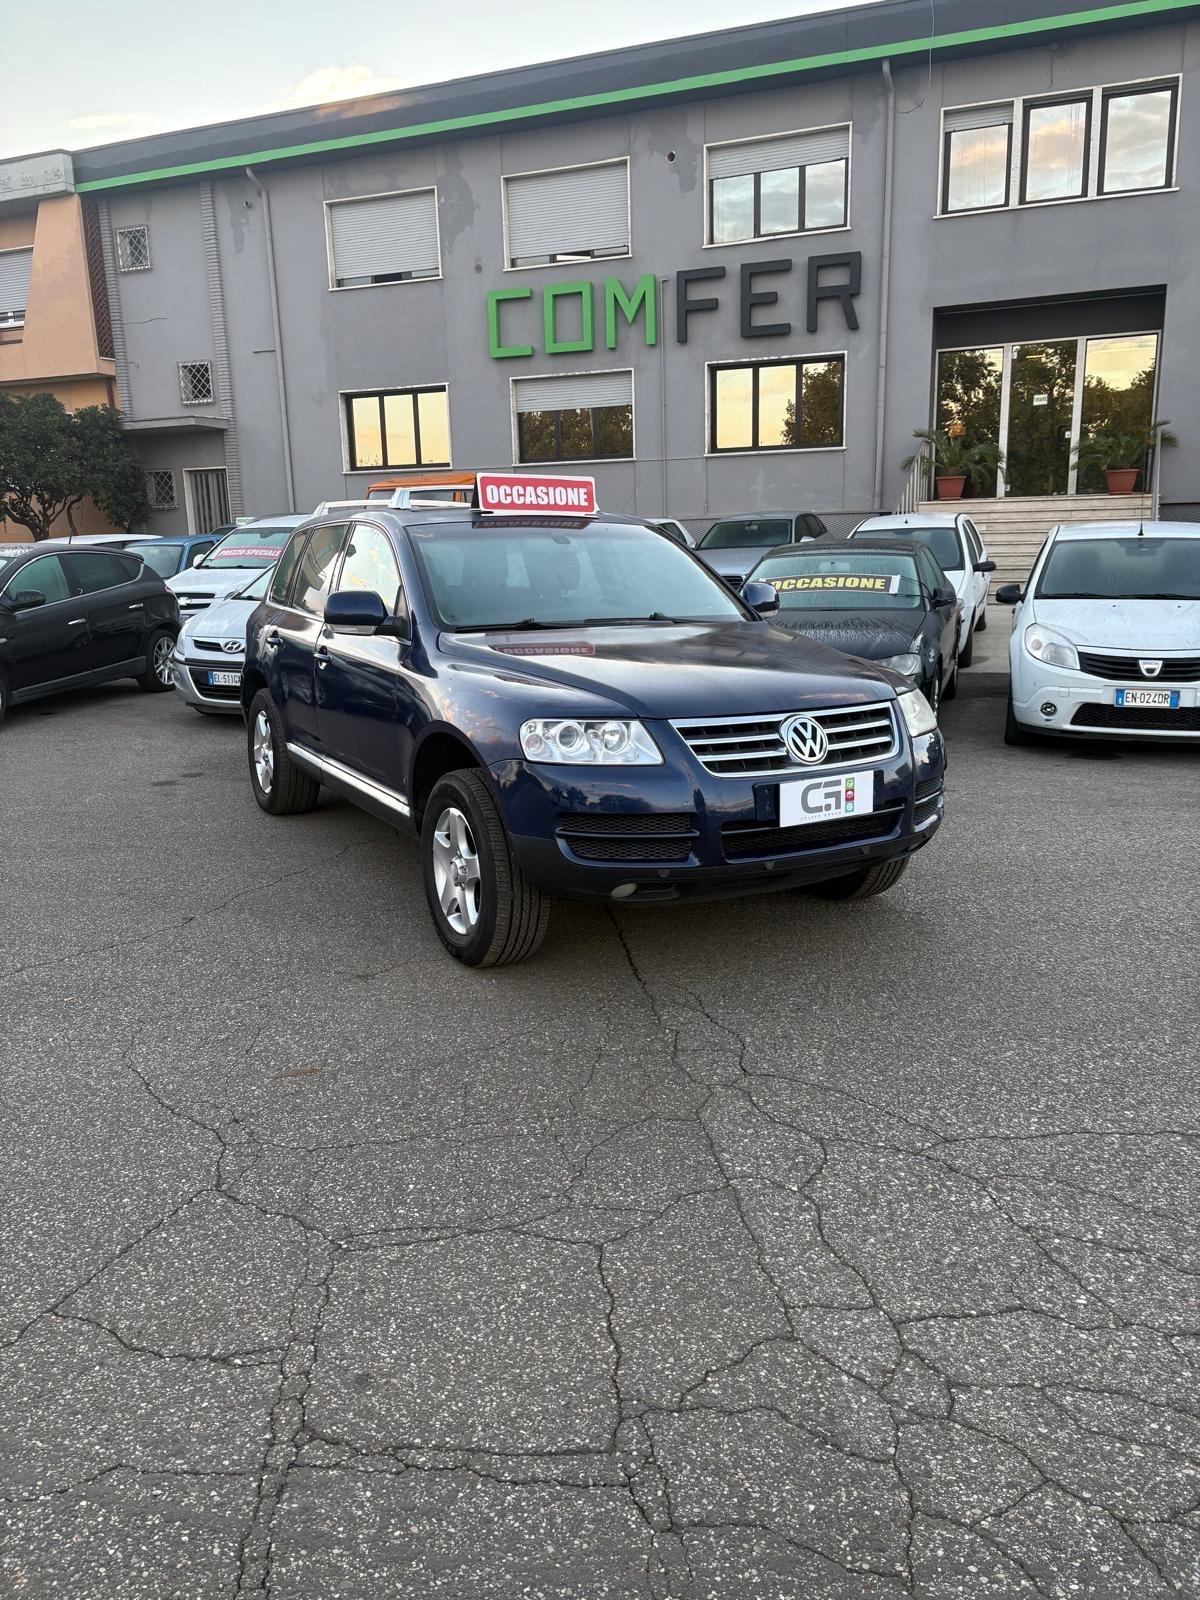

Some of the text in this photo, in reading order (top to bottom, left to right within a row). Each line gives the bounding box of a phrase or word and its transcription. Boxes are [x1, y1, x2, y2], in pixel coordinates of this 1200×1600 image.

[487, 251, 861, 358] COMFER
[486, 485, 588, 506] OCCASIONE
[219, 549, 245, 557] PREZZO
[771, 577, 885, 589] OCCASIONE
